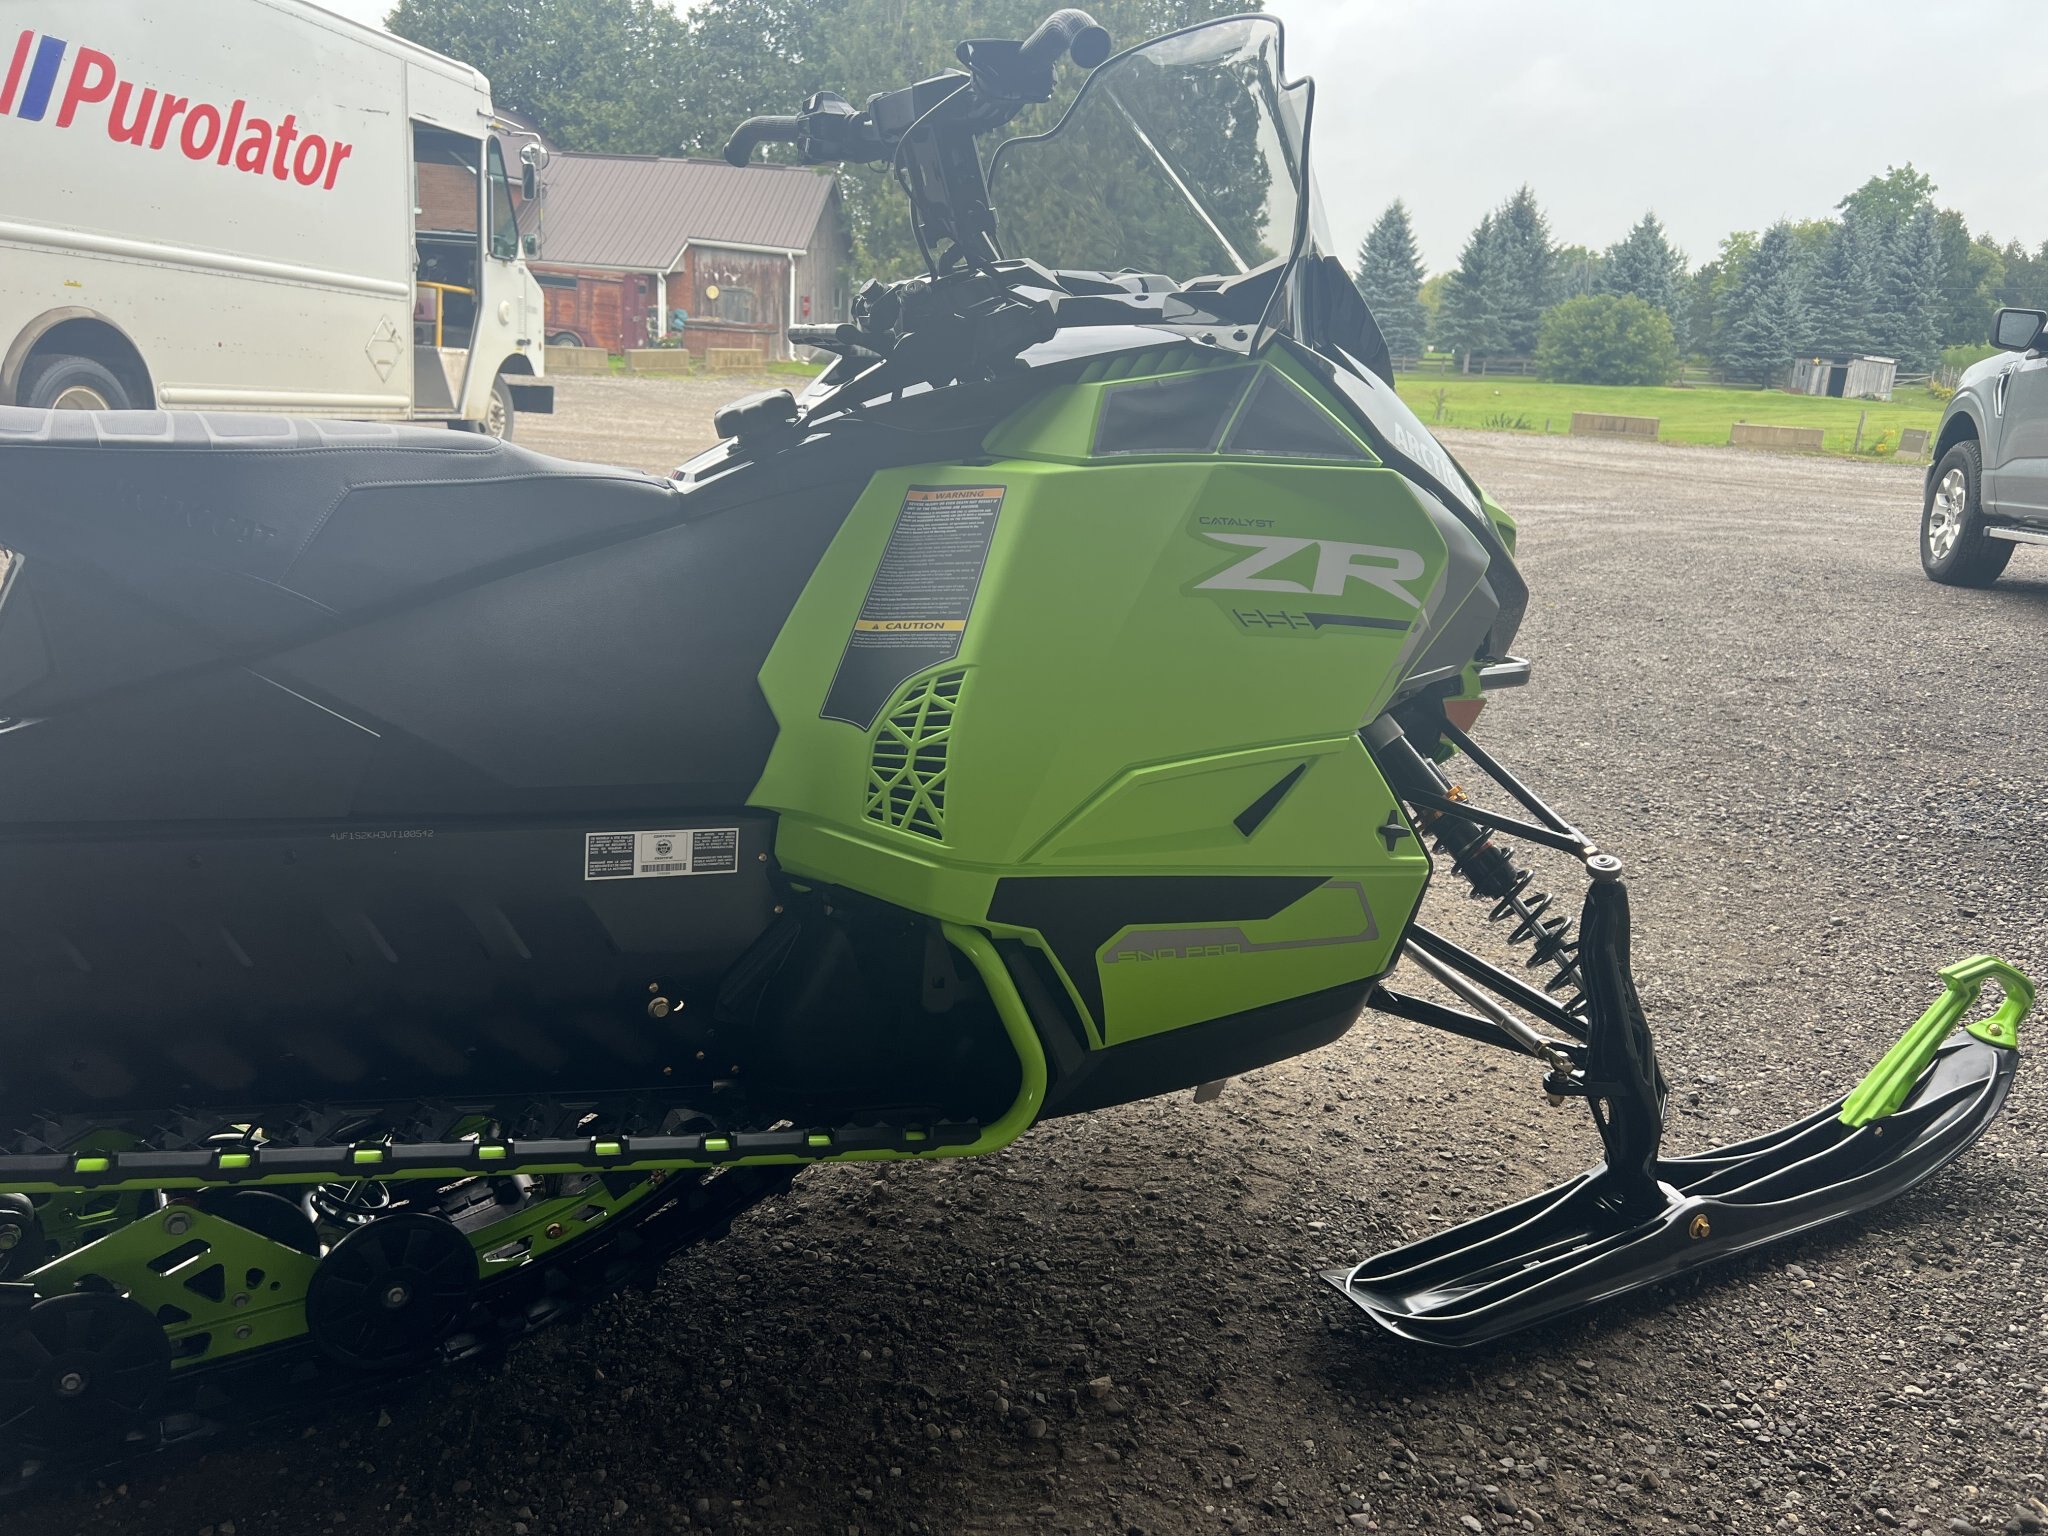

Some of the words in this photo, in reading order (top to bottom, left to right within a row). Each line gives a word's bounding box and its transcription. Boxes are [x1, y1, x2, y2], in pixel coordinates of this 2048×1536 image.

[57, 46, 352, 190] Purolator
[1394, 422, 1458, 493] ARCTIC
[935, 490, 984, 499] WARNING
[1199, 516, 1275, 528] CATALYST
[1193, 532, 1426, 612] ZR
[885, 622, 945, 630] CAUTION
[1117, 947, 1176, 962] SNO
[1186, 943, 1240, 959] PRO
